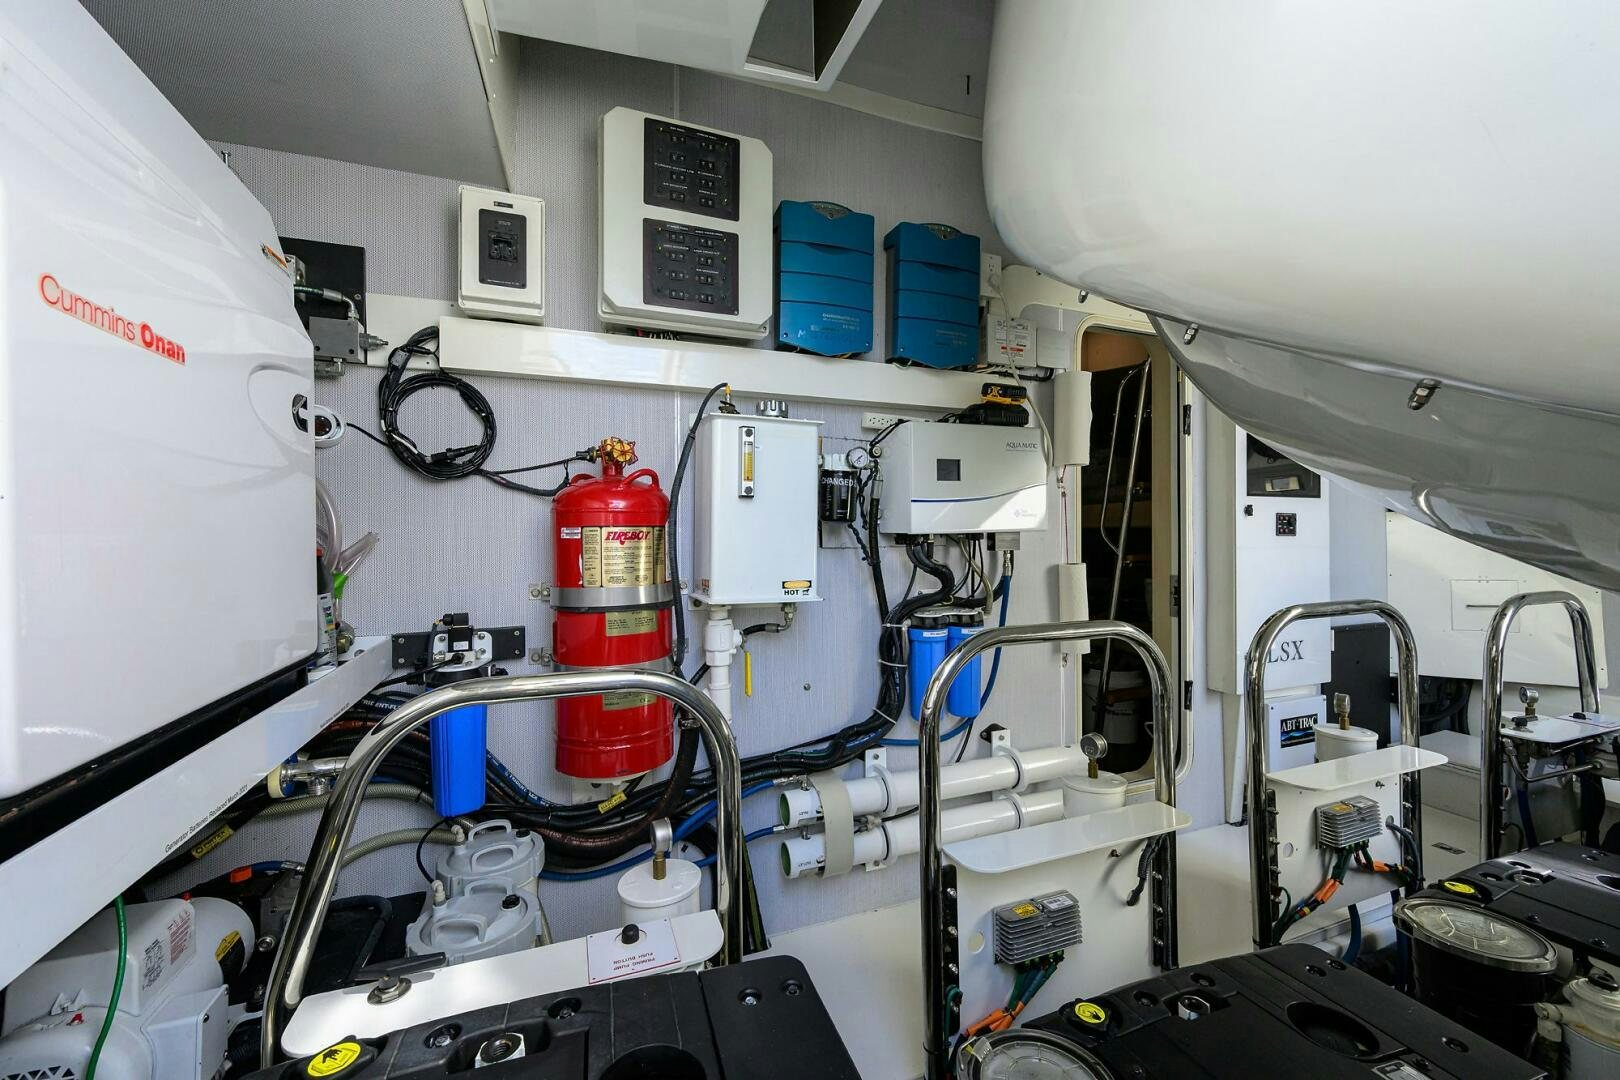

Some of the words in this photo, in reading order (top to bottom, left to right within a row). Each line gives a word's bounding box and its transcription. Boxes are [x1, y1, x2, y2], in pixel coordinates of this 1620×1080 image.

[41, 275, 136, 341] Cummins
[140, 323, 185, 363] Onan
[821, 477, 854, 487] CHANGED
[605, 531, 651, 546] FIREBOY
[1267, 640, 1304, 664] LSX
[165, 831, 188, 852] Generator
[614, 956, 635, 964] BUTTON
